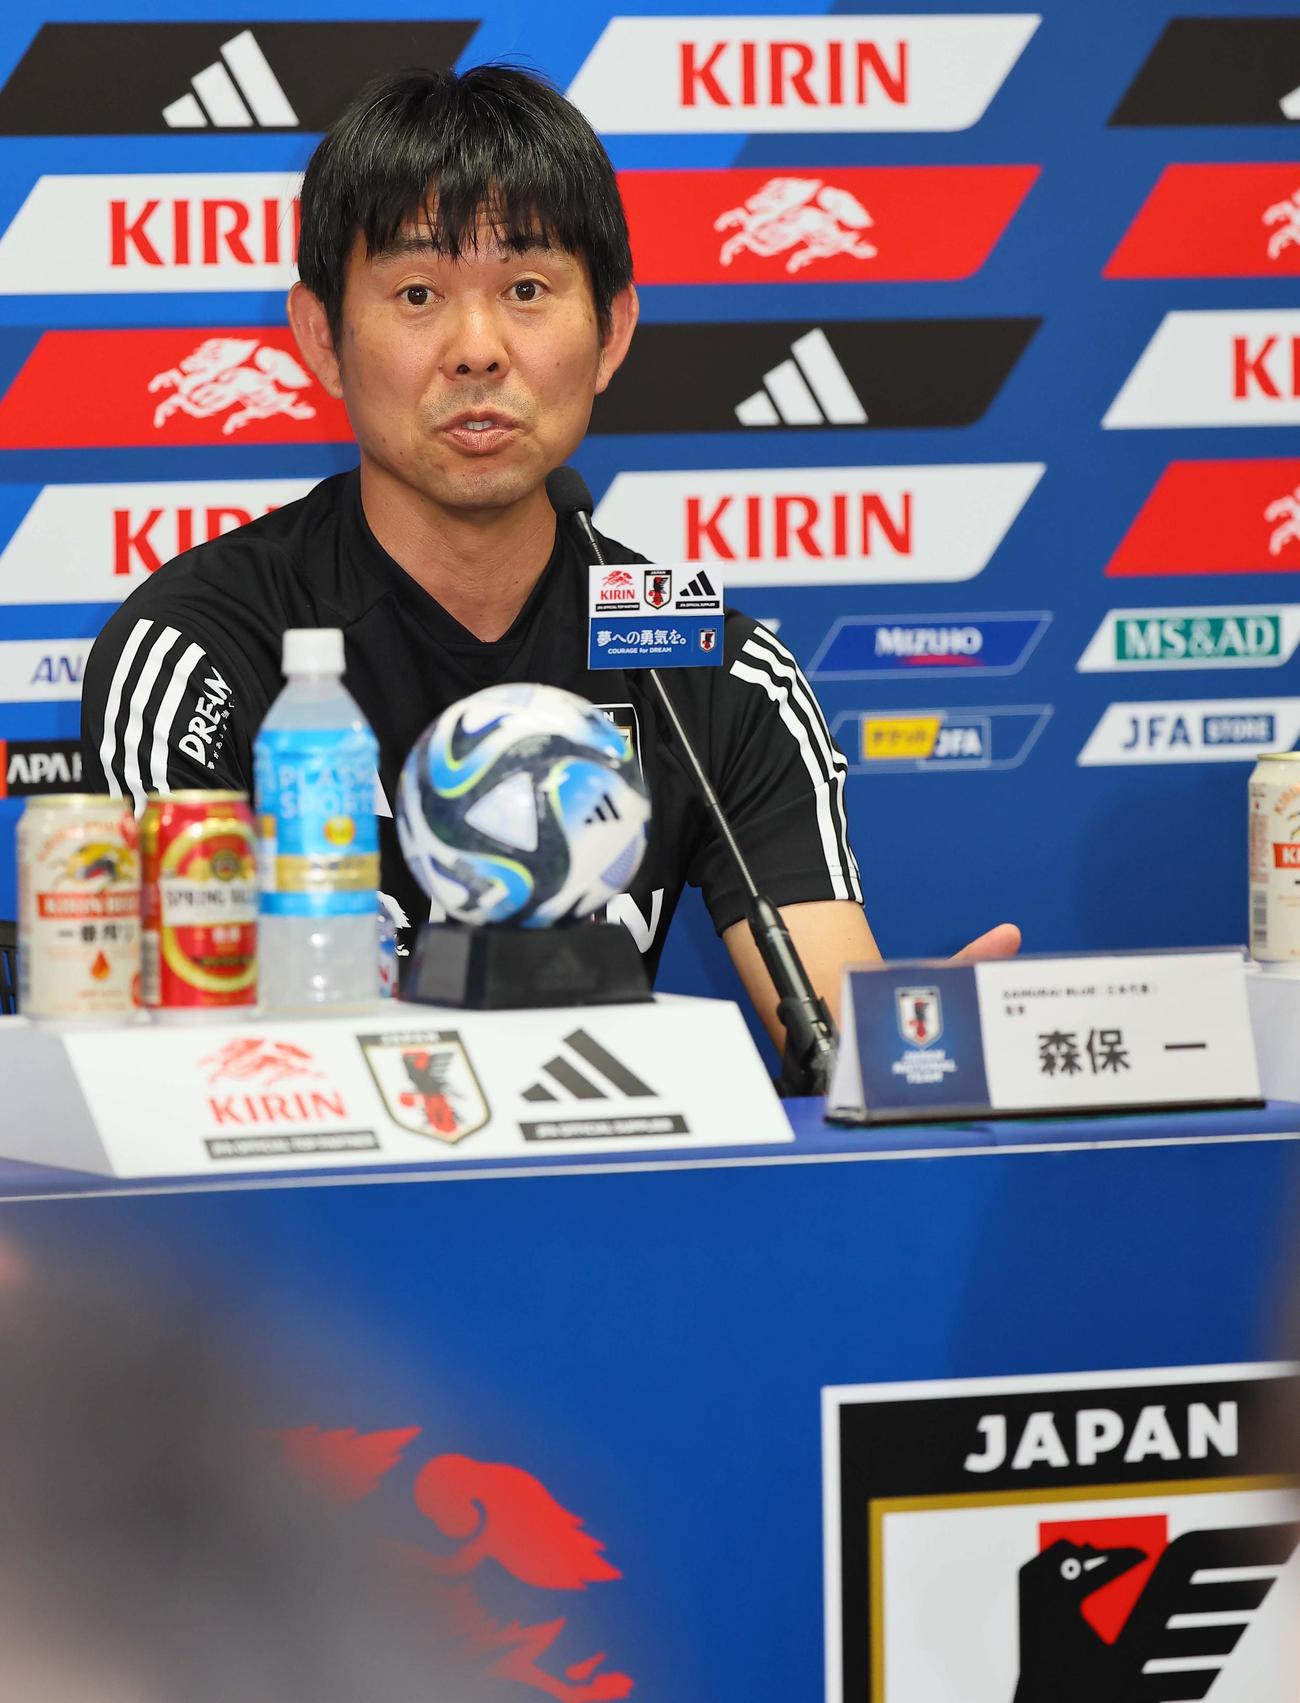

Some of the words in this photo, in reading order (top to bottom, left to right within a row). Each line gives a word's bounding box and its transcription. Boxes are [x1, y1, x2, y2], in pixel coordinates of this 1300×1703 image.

[679, 41, 908, 106] KIRIN
[685, 490, 913, 561] KIRIN
[600, 589, 635, 601] KIRIN
[597, 629, 687, 646] 夢への勇気を。
[1125, 616, 1276, 659] MS&AD
[1122, 716, 1191, 750] JFA
[1206, 717, 1269, 743] STORE
[1038, 1028, 1130, 1077] 森保
[208, 1089, 348, 1125] KIRIN
[964, 1401, 1238, 1473] JAPAN
